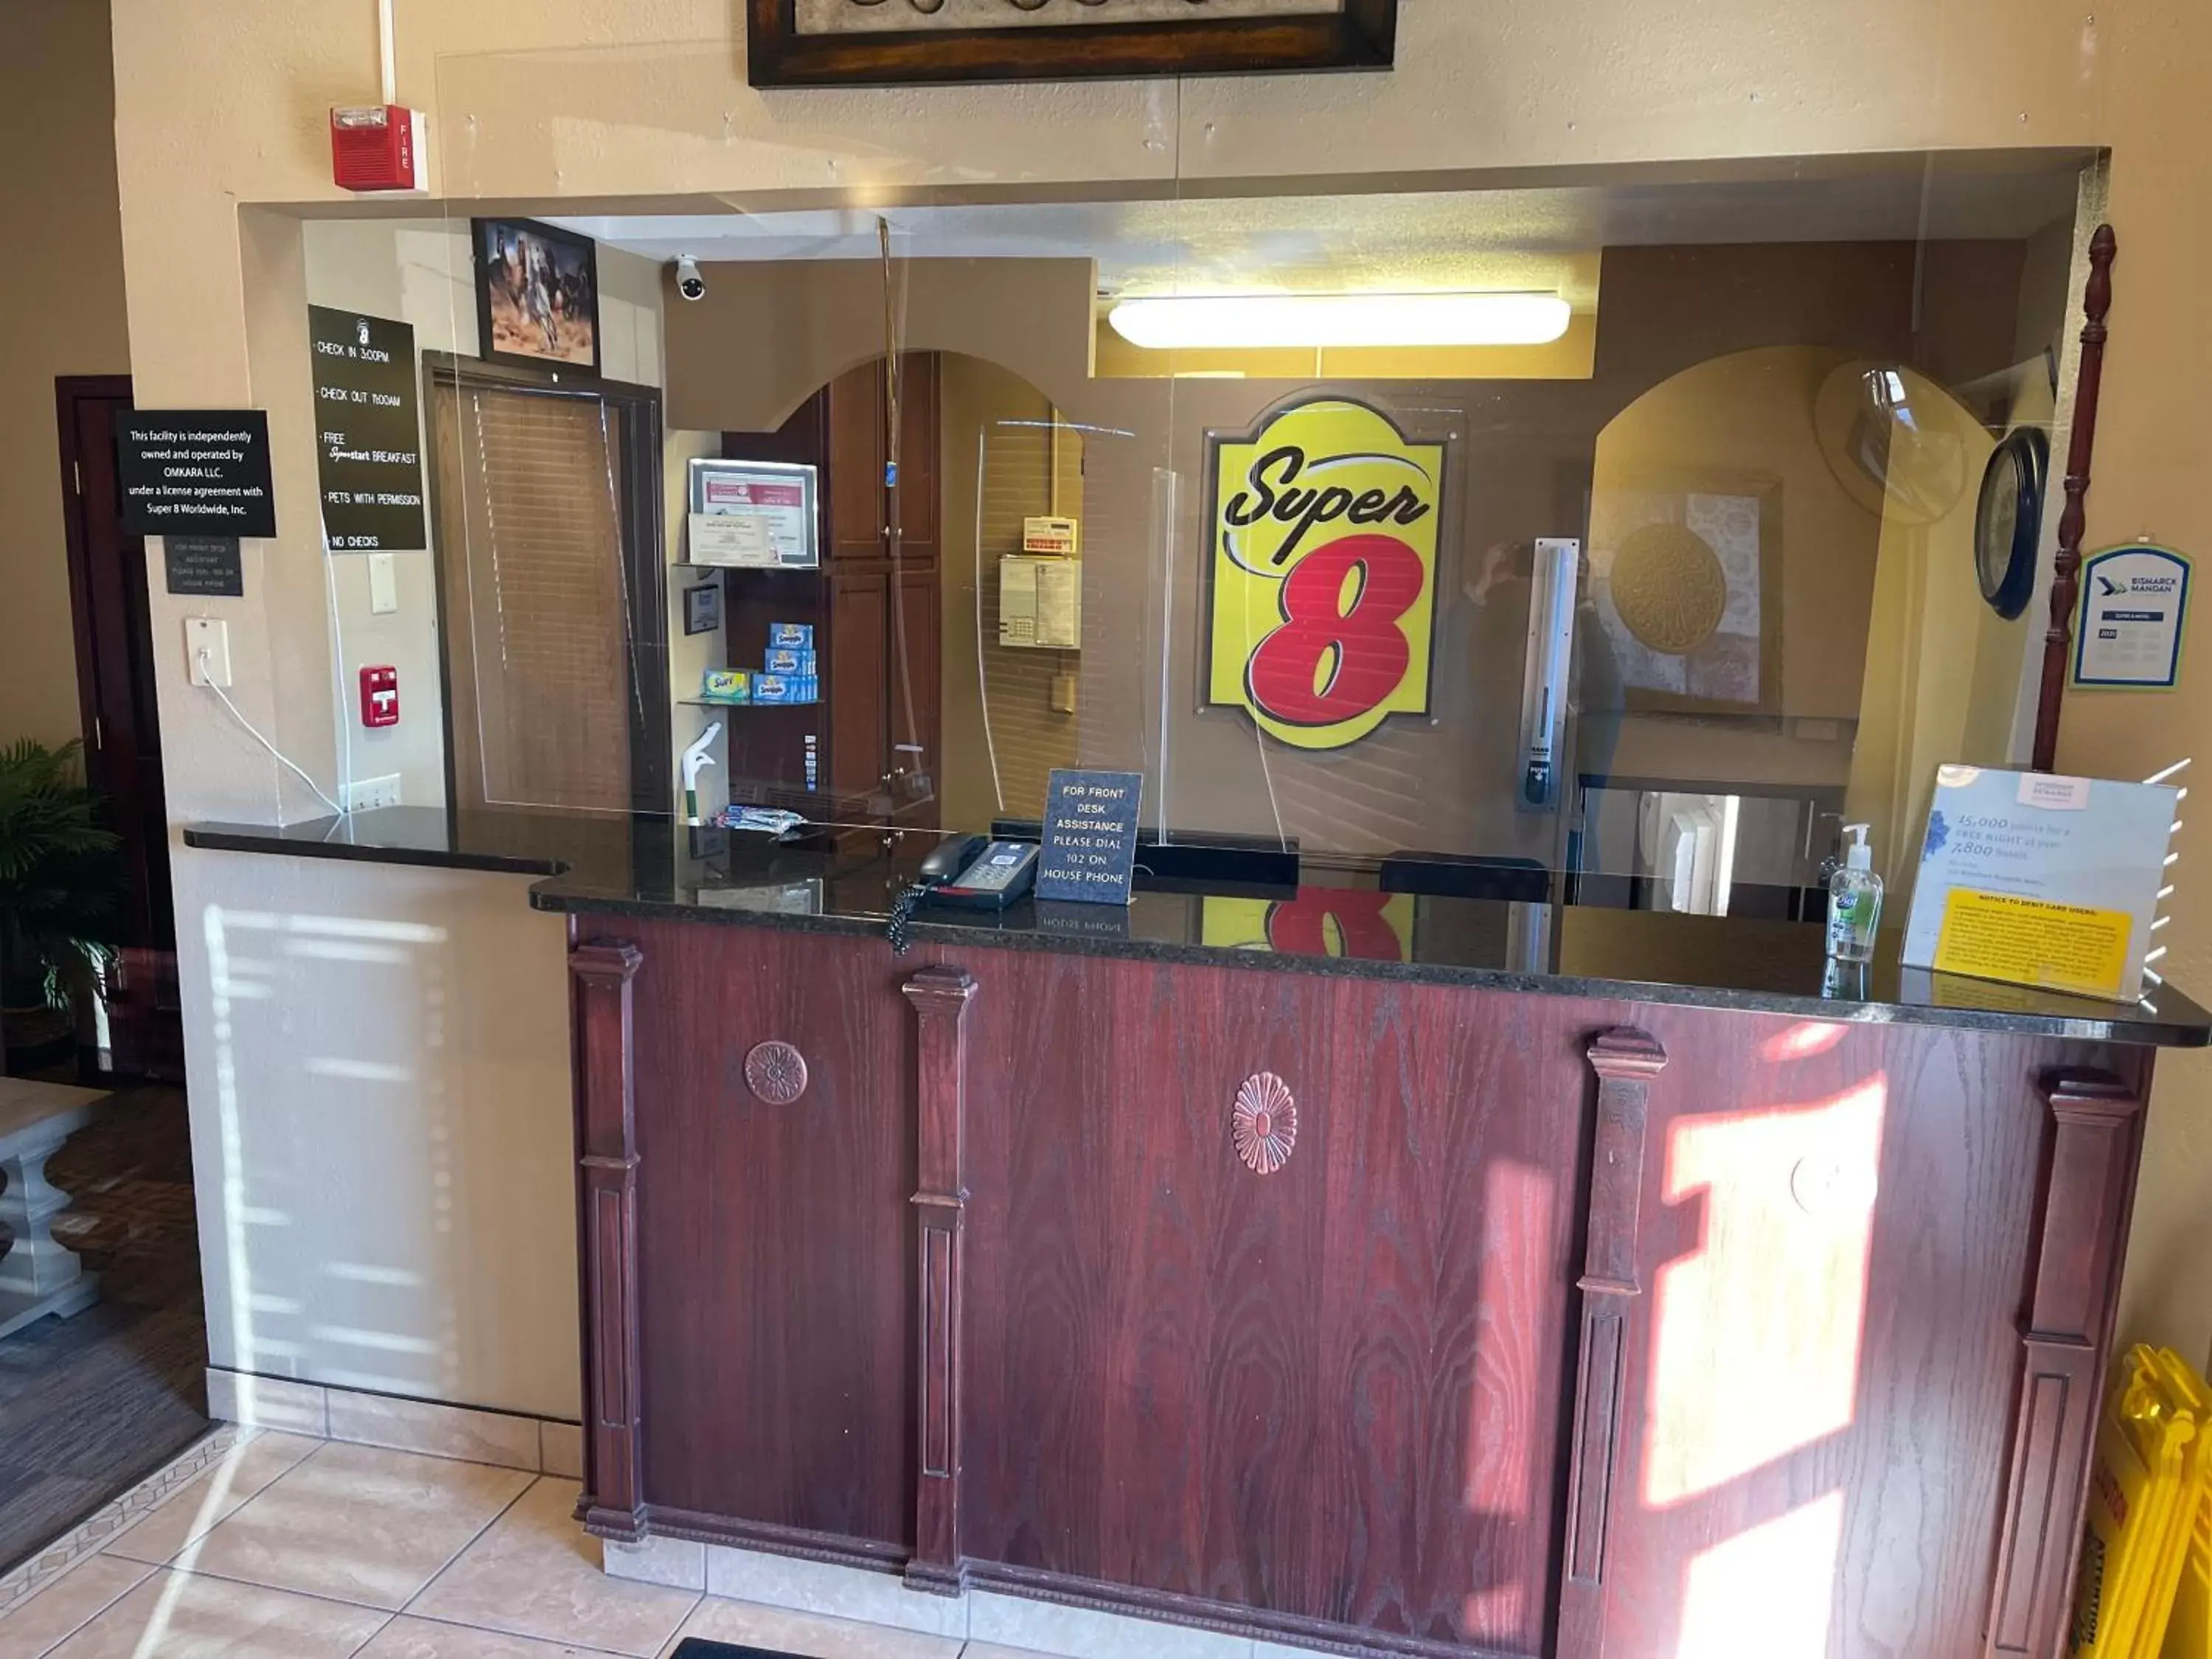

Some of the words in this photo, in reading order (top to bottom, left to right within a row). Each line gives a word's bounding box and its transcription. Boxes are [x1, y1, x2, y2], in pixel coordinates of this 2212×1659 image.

[400, 125, 409, 169] FIRE
[318, 341, 344, 356] CHECK
[348, 346, 356, 358] IN
[321, 387, 347, 400] CHECK
[351, 390, 367, 403] OUT
[130, 431, 148, 442] This
[150, 431, 178, 442] facility
[179, 431, 186, 441] is
[188, 431, 251, 443] independently
[324, 431, 345, 445] FREE
[141, 449, 170, 459] owned
[173, 449, 189, 459] and
[191, 449, 231, 462] operated
[232, 449, 244, 462] by
[372, 451, 416, 464] BREAKFAST
[164, 467, 203, 478] OMKARA
[128, 484, 154, 495] under
[156, 487, 161, 495] a
[162, 484, 192, 496] license
[194, 487, 241, 498] agreement
[243, 486, 263, 496] with
[328, 492, 350, 504] PETS
[354, 493, 375, 504] WITH
[378, 493, 420, 506] PERMISSION
[1225, 445, 1431, 566] Super
[147, 503, 172, 515] Super
[173, 504, 179, 514] 8
[181, 504, 229, 515] Worldwide,
[231, 504, 247, 515] Inc.
[332, 536, 344, 547] NO
[347, 536, 378, 546] CHECKS
[1242, 533, 1426, 727] 8
[1062, 786, 1085, 797] FOR
[1088, 787, 1124, 799] FRONT
[1077, 804, 1106, 814] DESK
[1057, 819, 1124, 832] ASSISTANCE
[1958, 815, 2008, 829] 15,000
[1054, 835, 1091, 846] PLEASE
[1096, 838, 1121, 849] DIAL
[1986, 833, 2023, 846] NIGHT
[1065, 854, 1085, 863] 102
[1089, 855, 1107, 865] ON
[1043, 869, 1082, 881] HOUSE
[1086, 872, 1124, 884] PHONE
[1979, 894, 2006, 903] NOTICE
